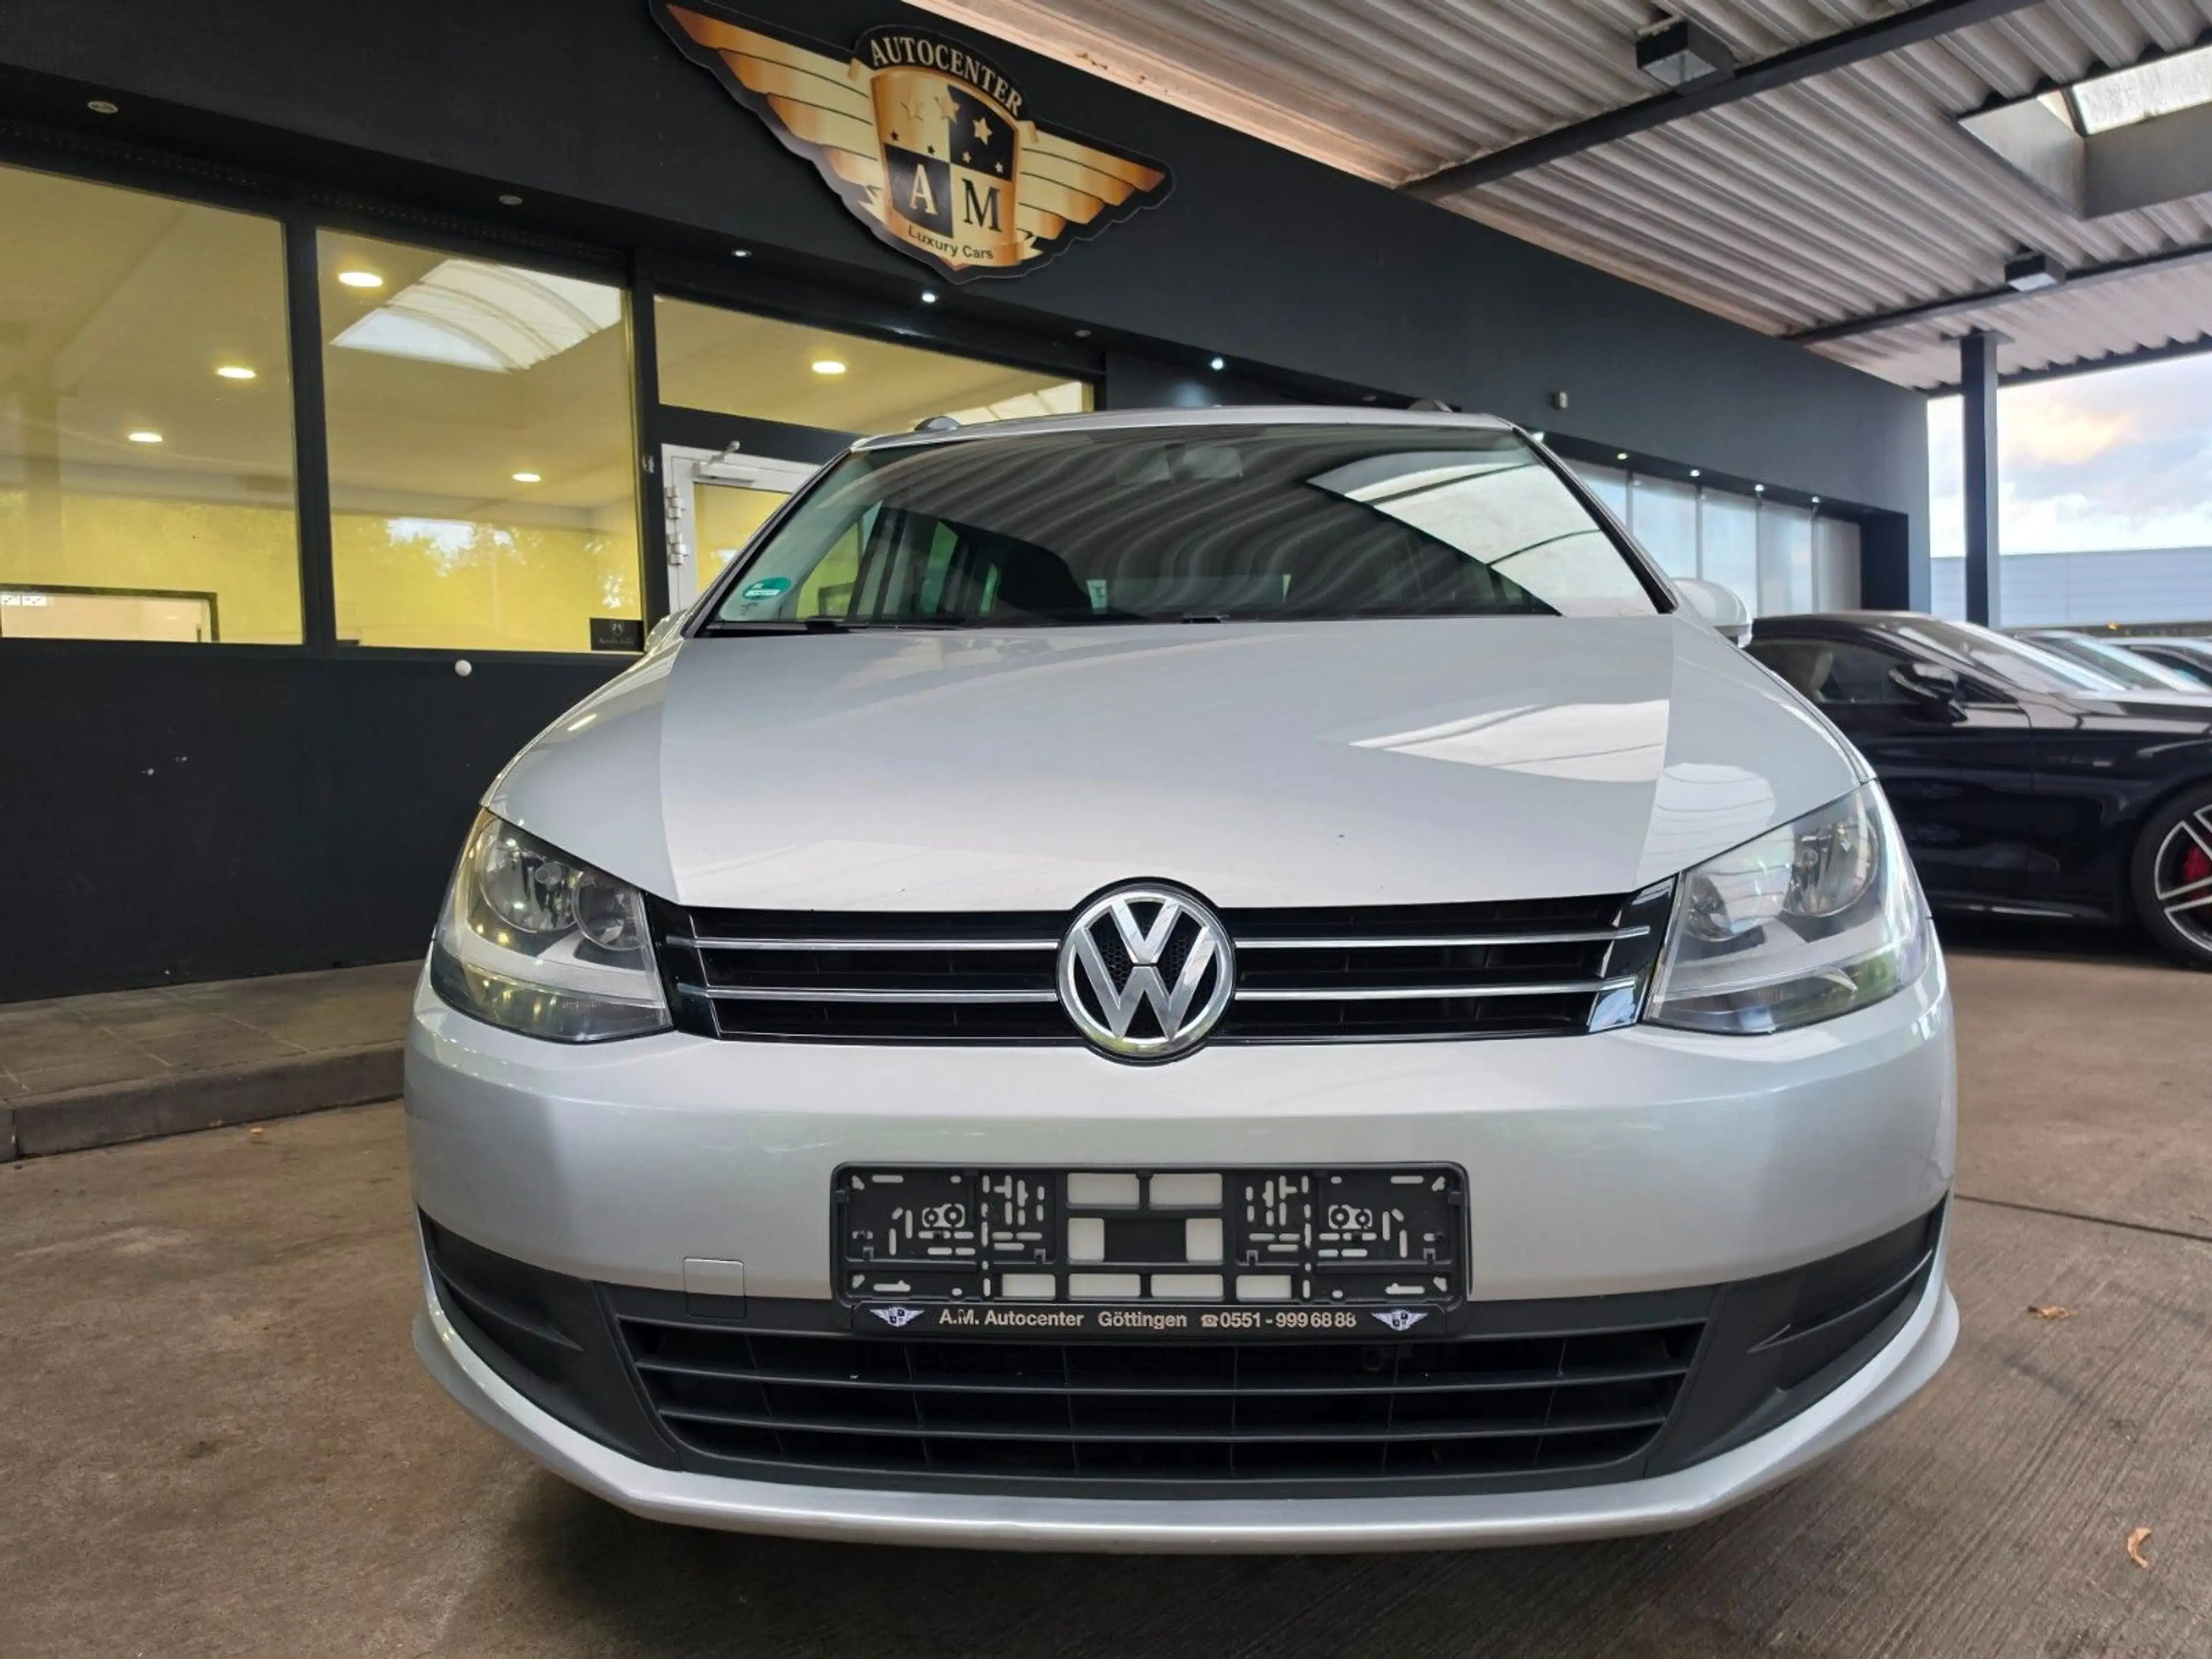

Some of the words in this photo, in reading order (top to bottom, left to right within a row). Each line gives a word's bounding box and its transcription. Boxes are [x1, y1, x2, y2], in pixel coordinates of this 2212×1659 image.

[870, 36, 1023, 117] AUTOCENTER
[909, 163, 939, 217] A
[961, 177, 1003, 233] M
[907, 225, 960, 257] Luxury
[962, 245, 994, 260] Cars
[939, 1308, 979, 1325] A.M.
[984, 1309, 1085, 1326] Autocenter
[1097, 1311, 1187, 1330] Göttingen
